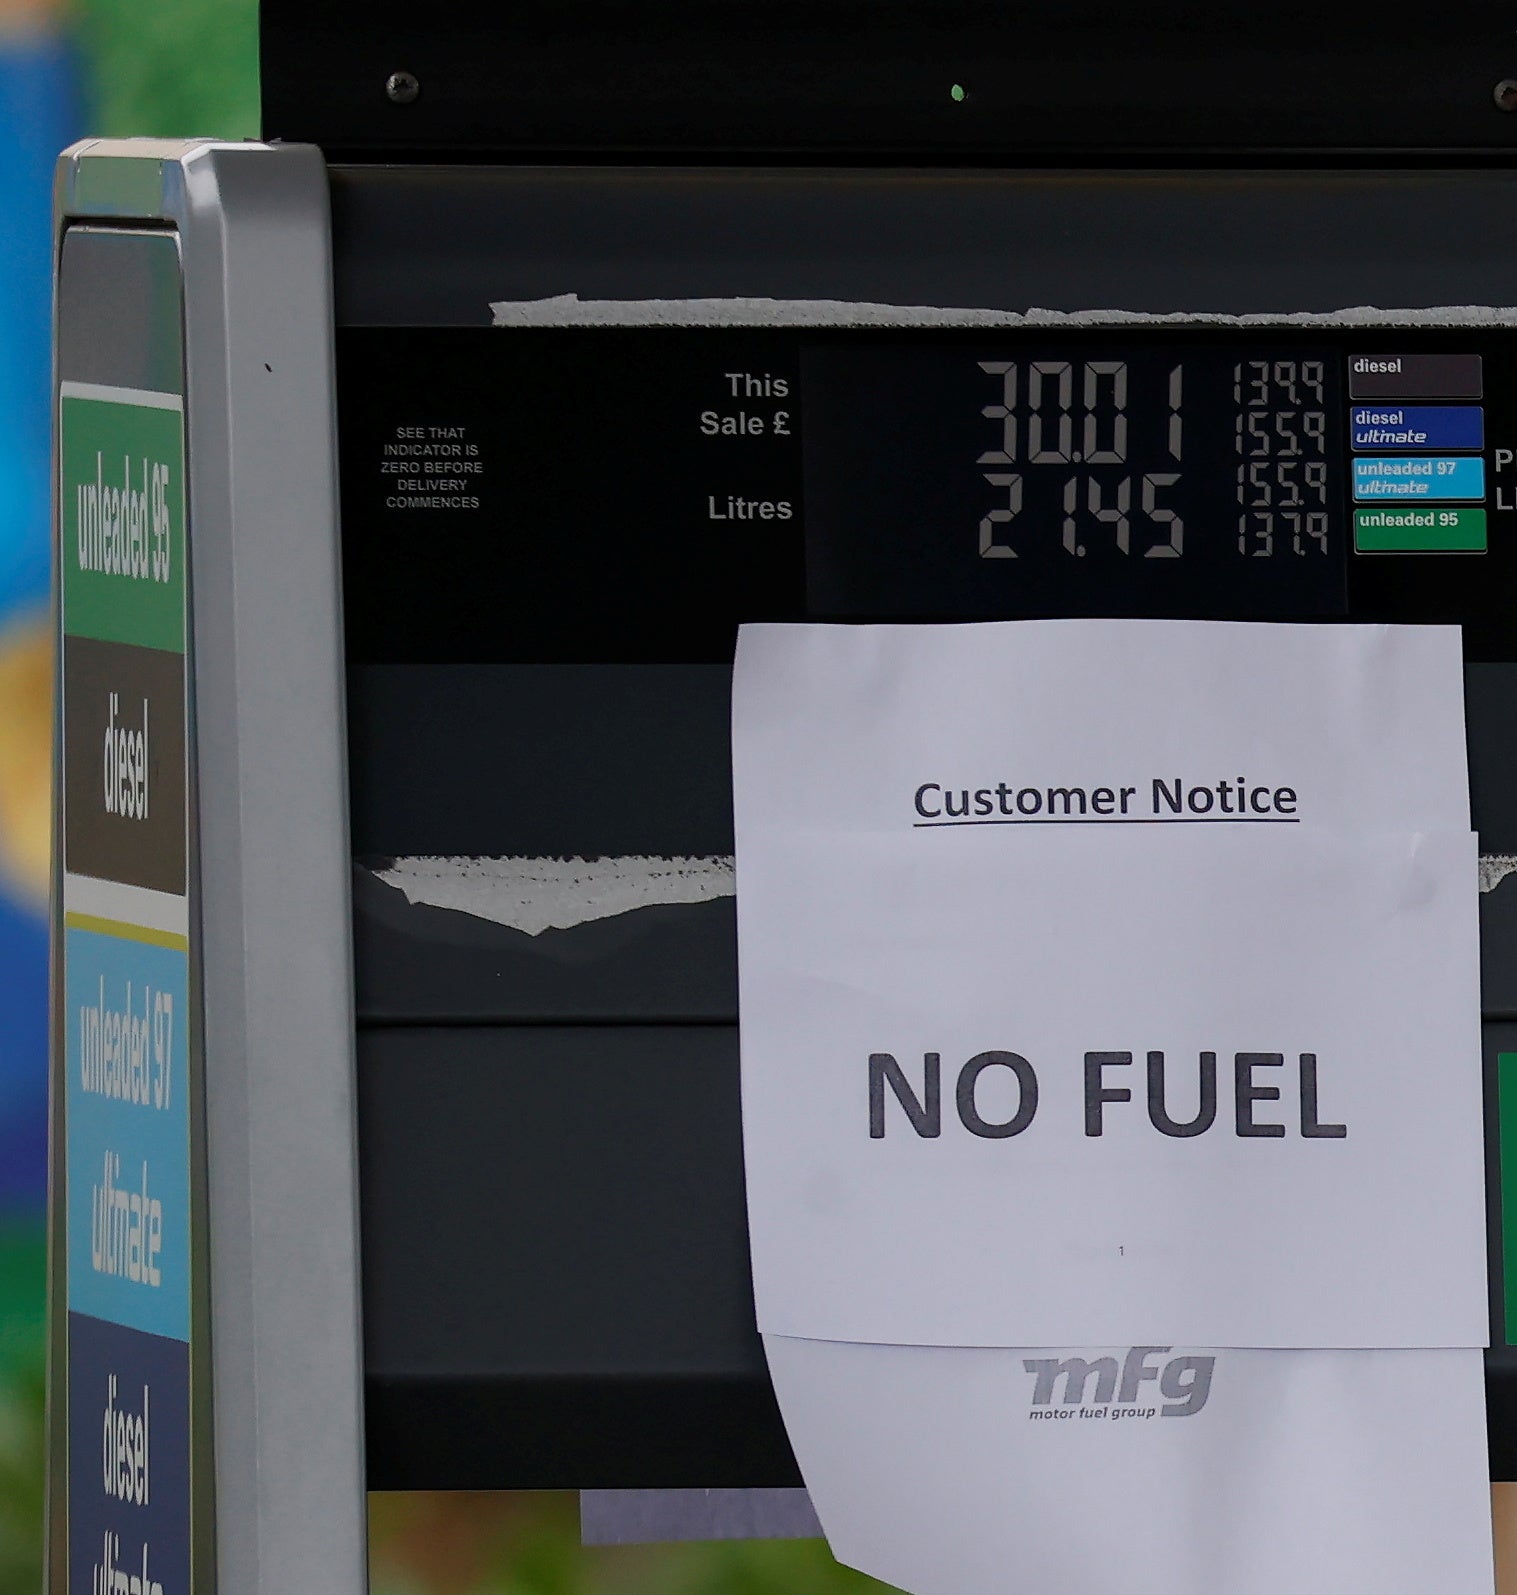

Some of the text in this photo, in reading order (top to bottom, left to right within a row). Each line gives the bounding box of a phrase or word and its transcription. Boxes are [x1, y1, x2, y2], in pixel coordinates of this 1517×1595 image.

[1354, 359, 1401, 372] diesel
[725, 373, 788, 397] This
[1234, 361, 1323, 405] 139.9
[700, 411, 790, 434] Sale £
[976, 362, 1182, 464] 30.01
[1356, 411, 1402, 424] diesel
[397, 427, 465, 438] SEE THAT
[1236, 412, 1325, 456] 155.9
[1357, 430, 1426, 442] ultimate
[385, 445, 478, 455] INDICATOR IS
[381, 462, 483, 473] ZERO BEFORE
[1358, 462, 1456, 477] unleaded 97
[398, 480, 467, 490] DELIVERY
[1237, 462, 1326, 506] 155.9
[1355, 479, 1429, 496] ultimate
[387, 497, 479, 508] COMMENCES
[709, 496, 792, 519] Litres
[78, 451, 170, 583] unleaded 95
[979, 473, 1183, 558] 21.45
[1360, 512, 1458, 526] unleaded 95
[1239, 512, 1328, 556] 137.9
[104, 692, 148, 819] diesel
[915, 777, 1297, 817] Customer Notice
[80, 974, 172, 1110] unleaded 97
[869, 1051, 1347, 1139] NO FUEL
[92, 1150, 161, 1287] ultimate
[1030, 1407, 1155, 1420] motor fuel group
[104, 1373, 149, 1506] diesel
